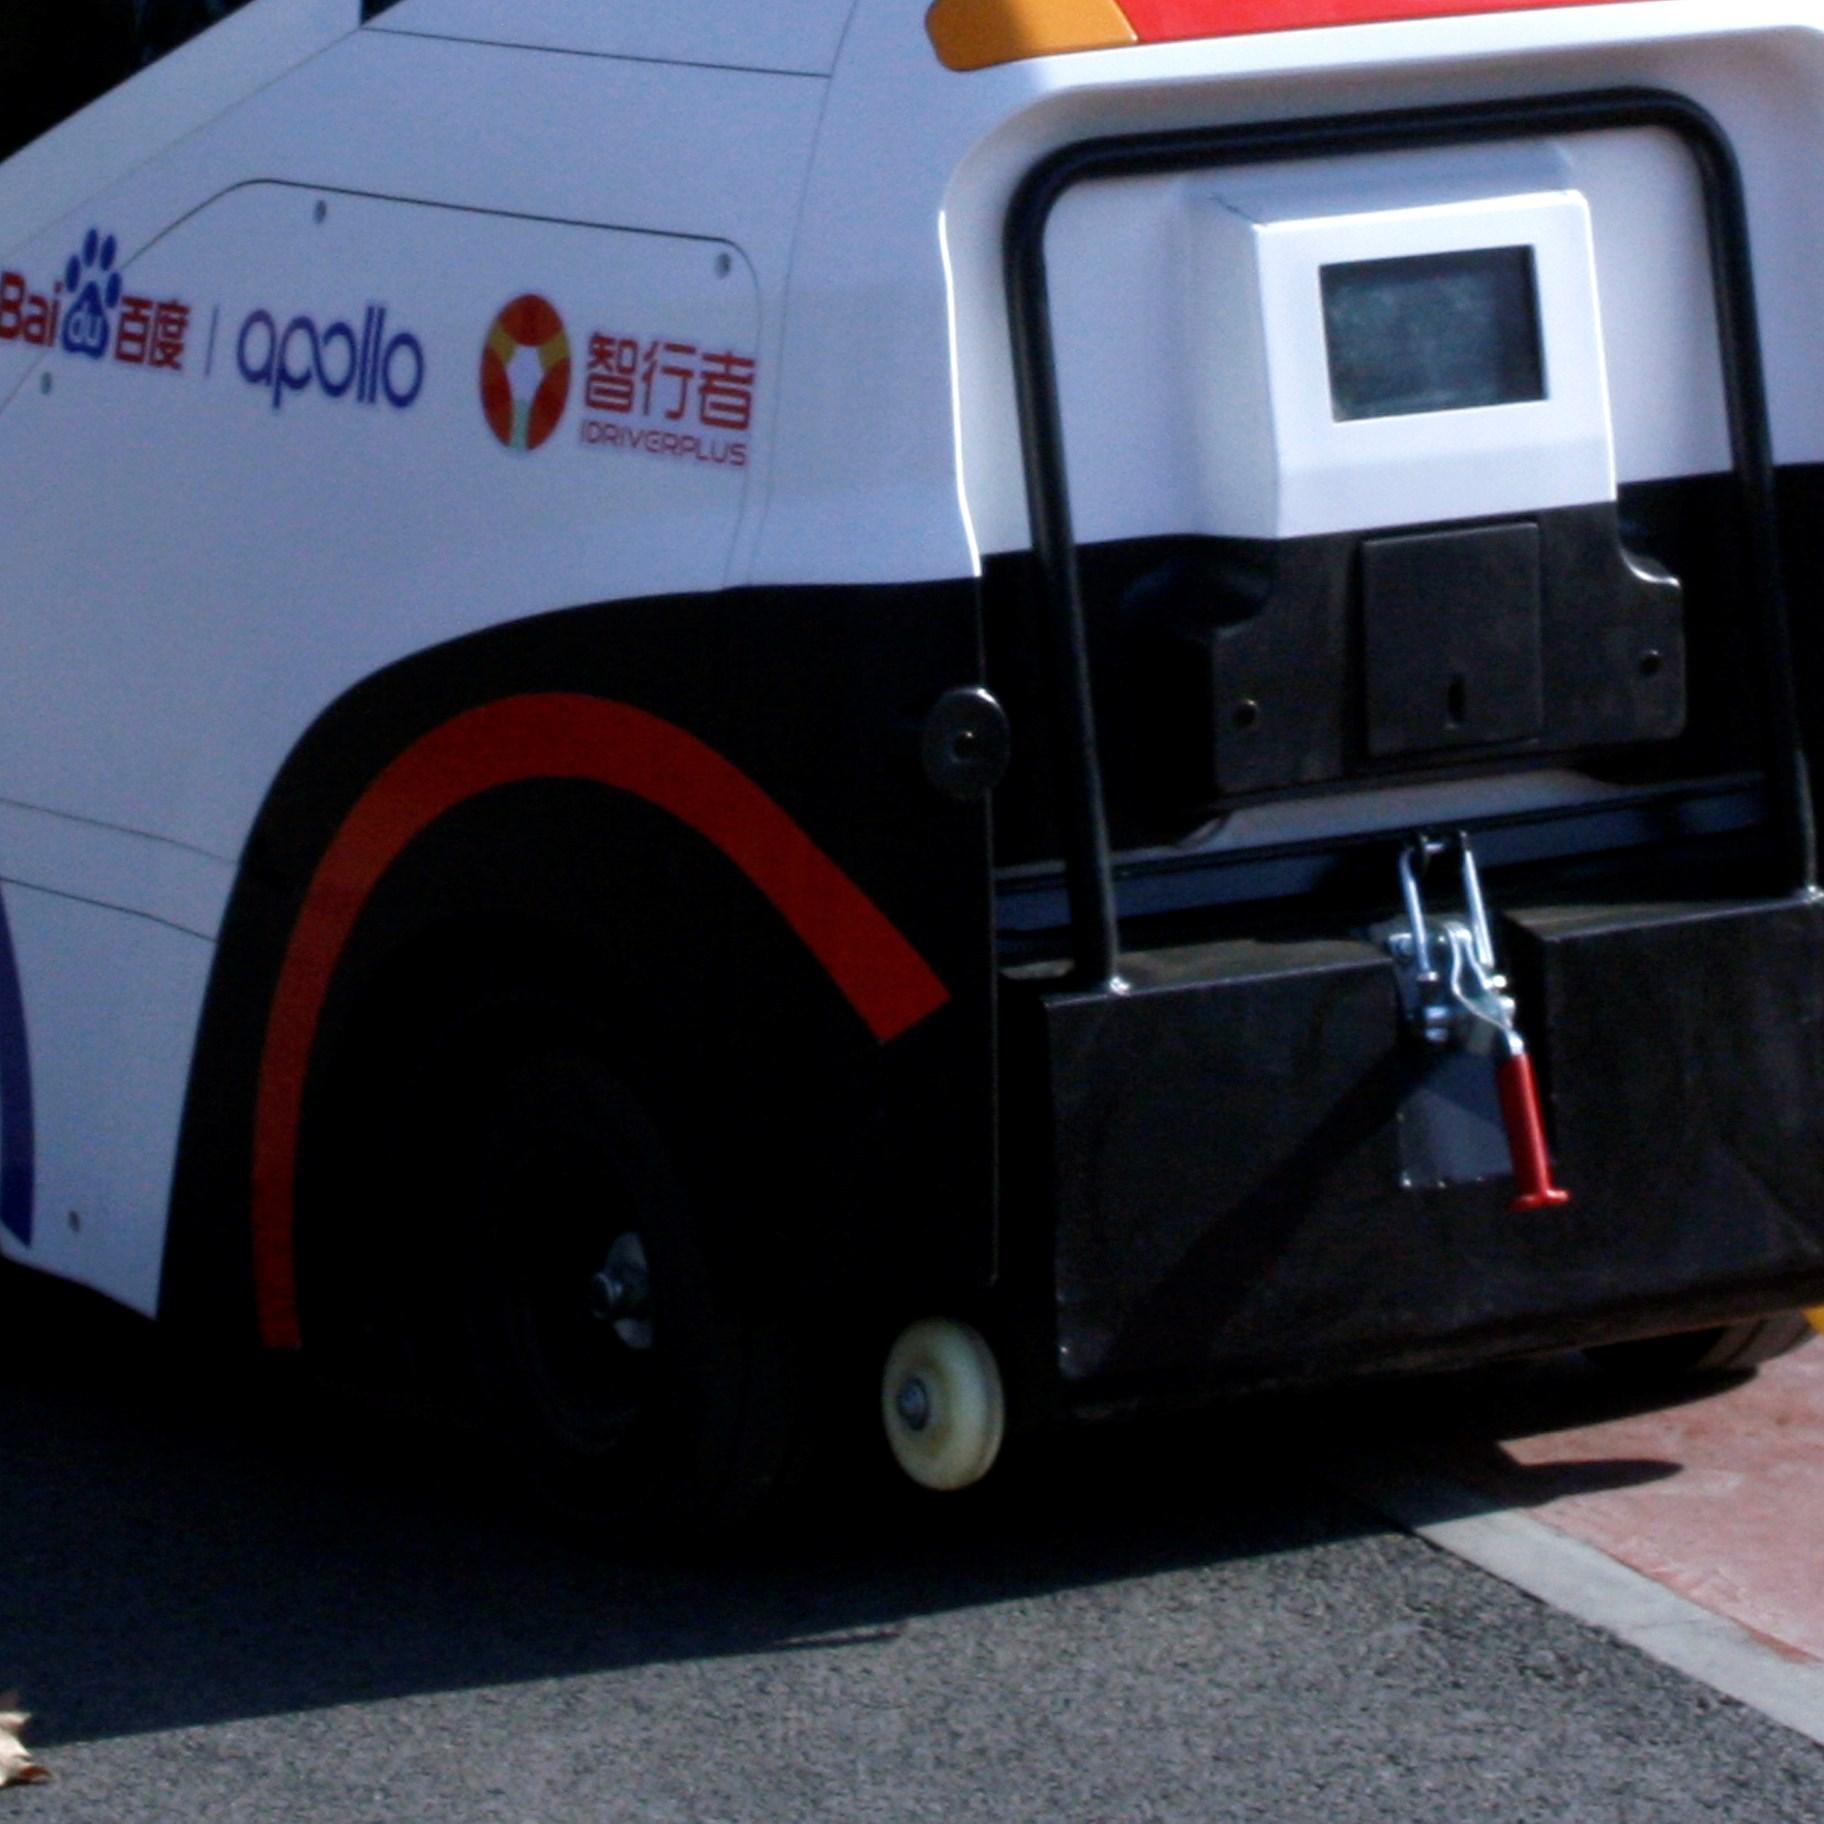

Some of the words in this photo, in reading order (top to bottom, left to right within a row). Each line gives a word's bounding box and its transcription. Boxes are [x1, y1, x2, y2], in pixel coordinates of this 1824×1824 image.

[237, 301, 425, 411] apollo
[585, 331, 756, 431] 智行者
